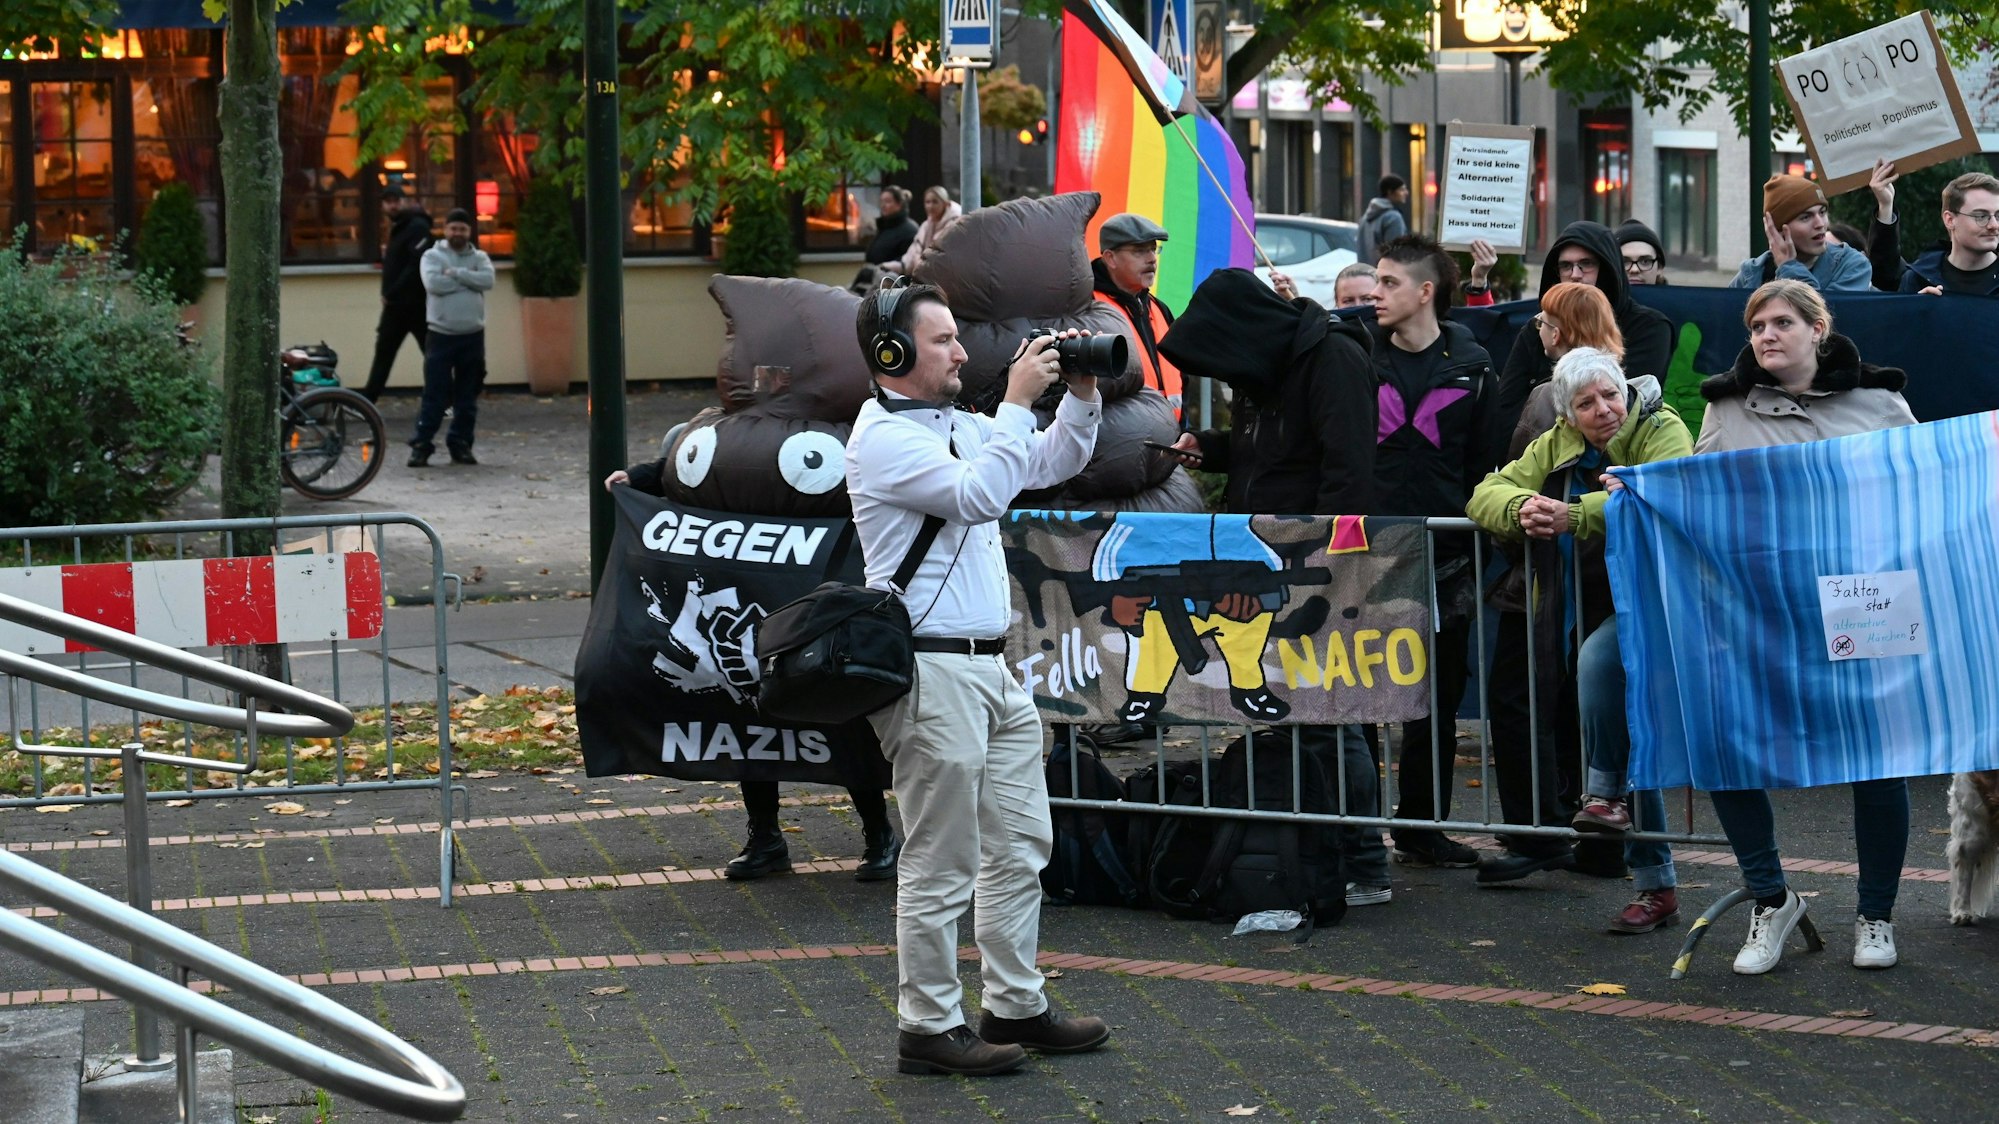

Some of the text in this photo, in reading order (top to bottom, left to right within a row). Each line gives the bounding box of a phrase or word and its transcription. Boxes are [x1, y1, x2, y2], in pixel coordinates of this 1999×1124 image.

[1796, 38, 1919, 98] PO PO
[1823, 99, 1938, 144] Politischer Populismus
[1456, 158, 1520, 169] Ihr seid keine
[1458, 173, 1513, 183] Alternative!
[1461, 194, 1505, 203] Solidarität
[1448, 219, 1470, 227] Hass
[1471, 220, 1487, 228] und
[642, 510, 828, 565] GEGEN
[1827, 578, 1879, 598] Fakten
[1864, 597, 1892, 612] statt
[1833, 618, 1887, 631] alternative
[1016, 627, 1103, 702] Fella
[1277, 627, 1427, 690] NAFO
[661, 721, 832, 764] NAZIS
